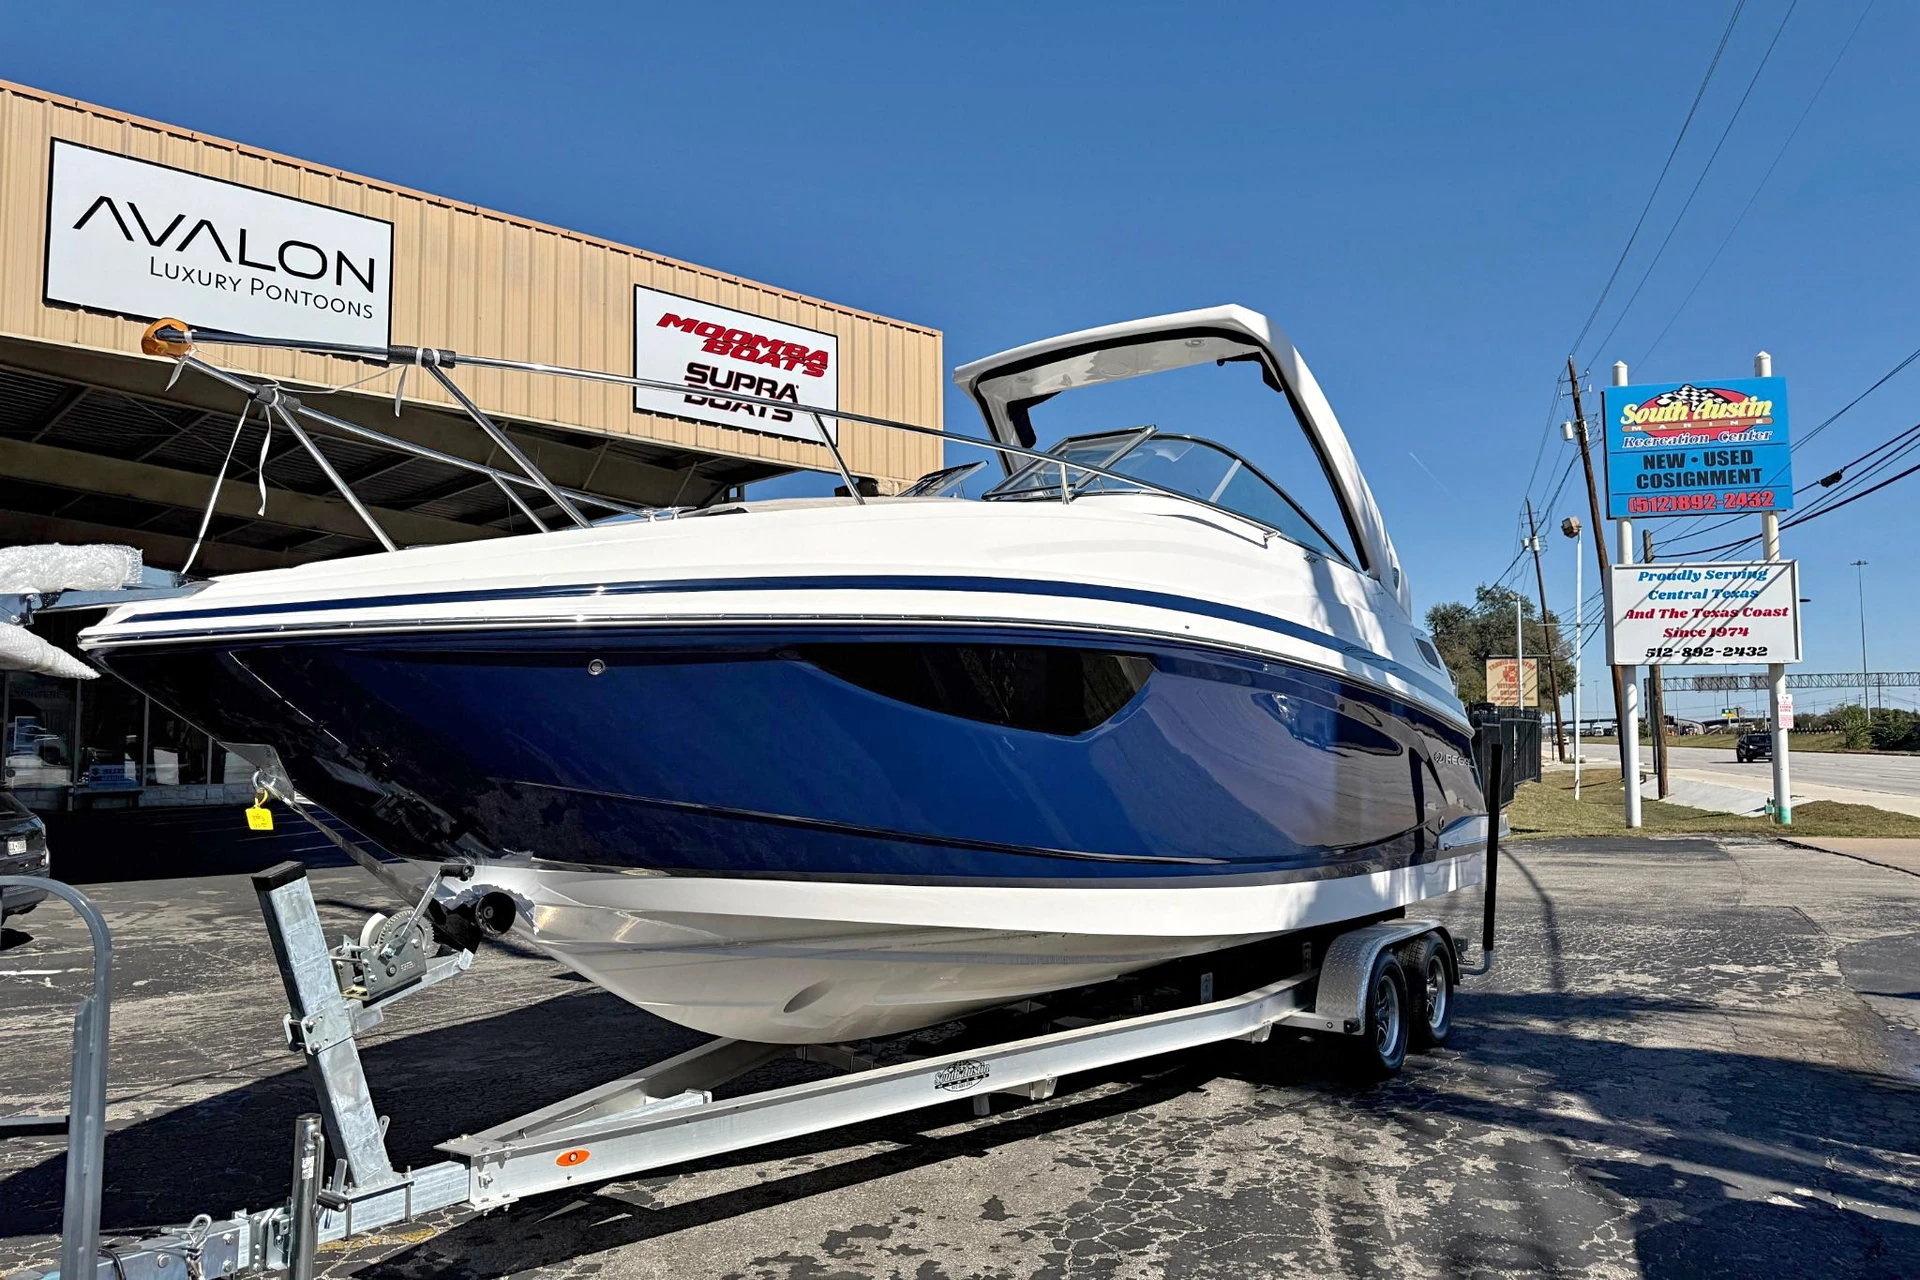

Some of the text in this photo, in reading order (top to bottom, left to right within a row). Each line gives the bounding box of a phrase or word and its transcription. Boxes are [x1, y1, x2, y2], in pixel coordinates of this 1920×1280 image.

[72, 195, 375, 293] AVALON
[656, 312, 829, 364] MOOMBA
[701, 339, 828, 378] BOATS
[684, 362, 799, 404] SUPRA
[1620, 396, 1773, 425] South Austin
[1631, 418, 1765, 431] MARINE
[1622, 428, 1773, 449] Recreation Center
[1643, 449, 1753, 470] NEW USED
[1636, 468, 1763, 489] COSIGNMENT
[1628, 490, 1775, 513] (512)892-2432
[1638, 567, 1769, 583] Proudly Serving
[1648, 588, 1760, 600] Central Texas
[1624, 606, 1789, 620] And The Texas Coast
[1662, 627, 1750, 638] Since 1974
[1644, 646, 1769, 658] 512-892-2432
